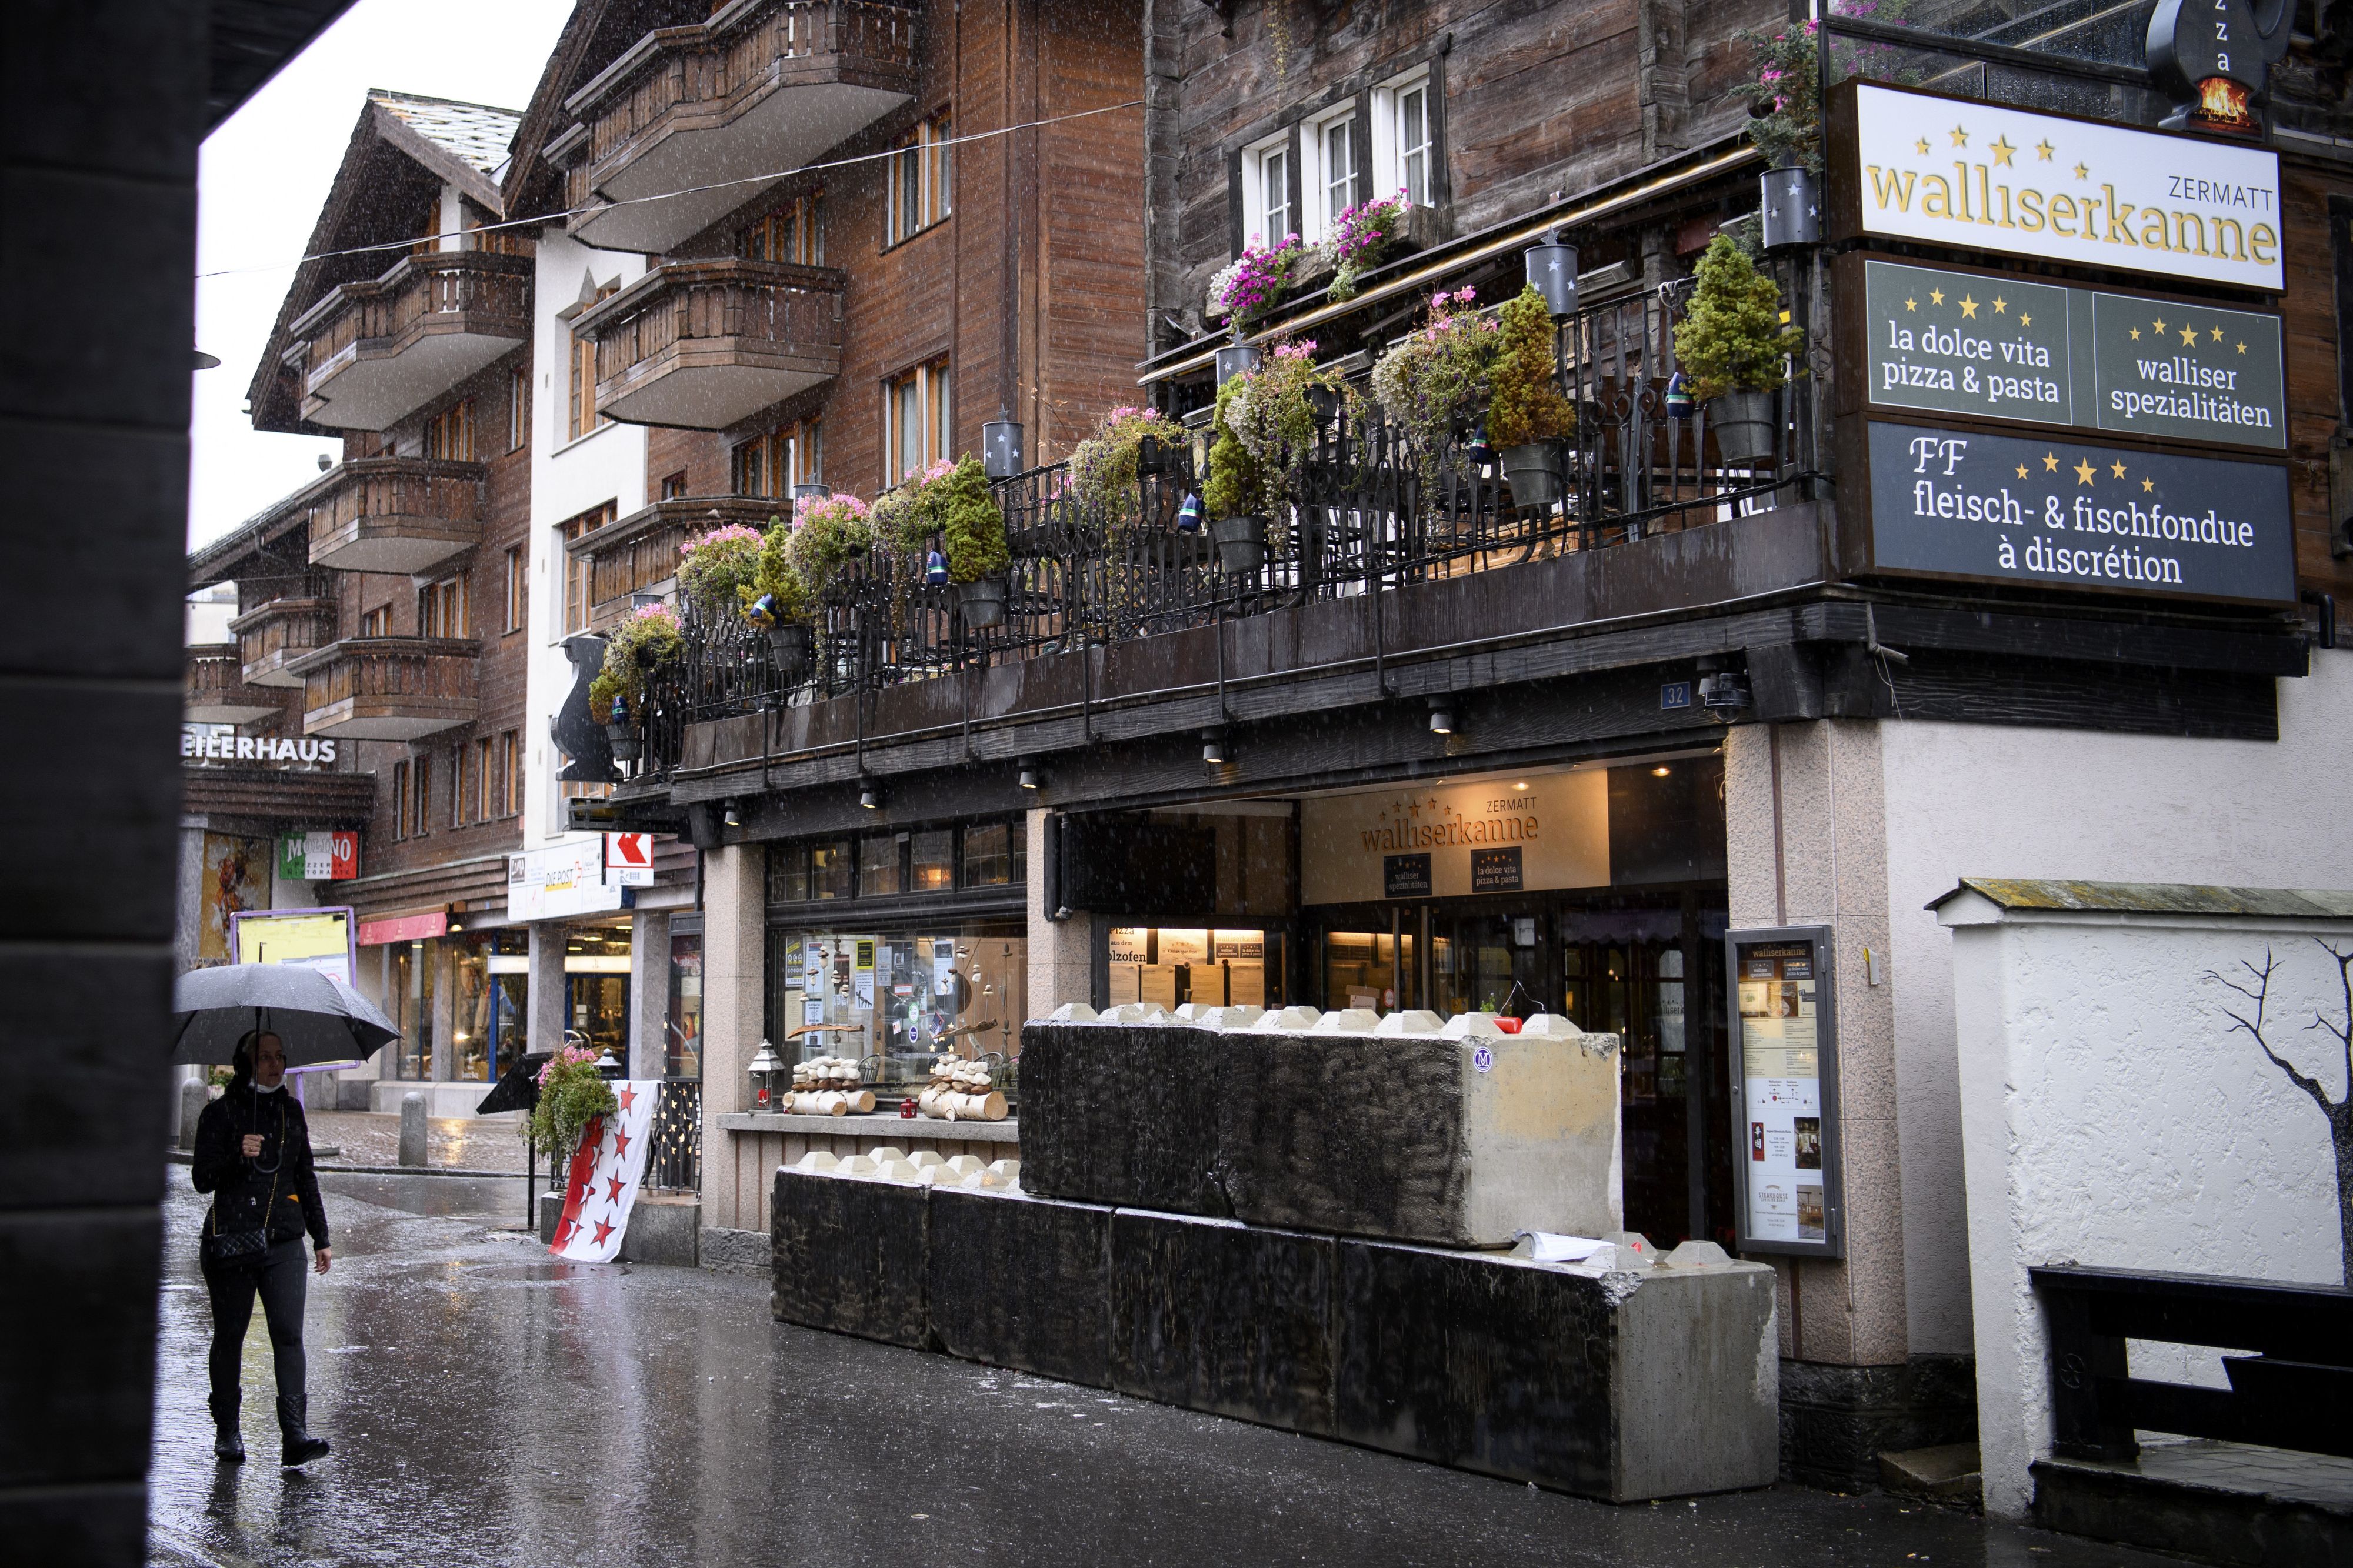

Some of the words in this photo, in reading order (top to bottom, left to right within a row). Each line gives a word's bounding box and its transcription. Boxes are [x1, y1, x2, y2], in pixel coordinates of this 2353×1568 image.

[2168, 175, 2274, 211] ZERMATT
[1866, 161, 2277, 266] walliserkanne
[1889, 320, 1915, 352] la
[1921, 325, 1993, 361] dolce
[1999, 341, 2051, 368] vita
[1882, 360, 1954, 392] pizza
[1962, 367, 1981, 394] &
[1987, 375, 2059, 403] pasta
[2137, 357, 2238, 391] walliser
[2111, 387, 2272, 428] spezialitäten
[1913, 480, 2034, 527] fleisch-
[2044, 496, 2066, 530] &
[2074, 496, 2254, 548] fischfondue
[1998, 534, 2017, 569] à
[2025, 536, 2183, 584] discrétion
[1668, 686, 1684, 704] 32
[180, 733, 336, 763] EILERHAUS
[1487, 796, 1537, 813] ZERMATT
[1361, 814, 1539, 852] walliserkanne
[287, 838, 351, 863] MOLINO
[546, 872, 556, 887] DIE
[558, 869, 574, 885] POST
[1395, 871, 1419, 880] walliser
[1476, 878, 1494, 887] pizza
[1501, 876, 1518, 885] pasta
[1478, 866, 1484, 875] la
[1485, 866, 1502, 875] dolce
[1504, 865, 1517, 873] vita
[1389, 880, 1428, 892] spezialitäten
[1752, 948, 1806, 958] walliserkanne
